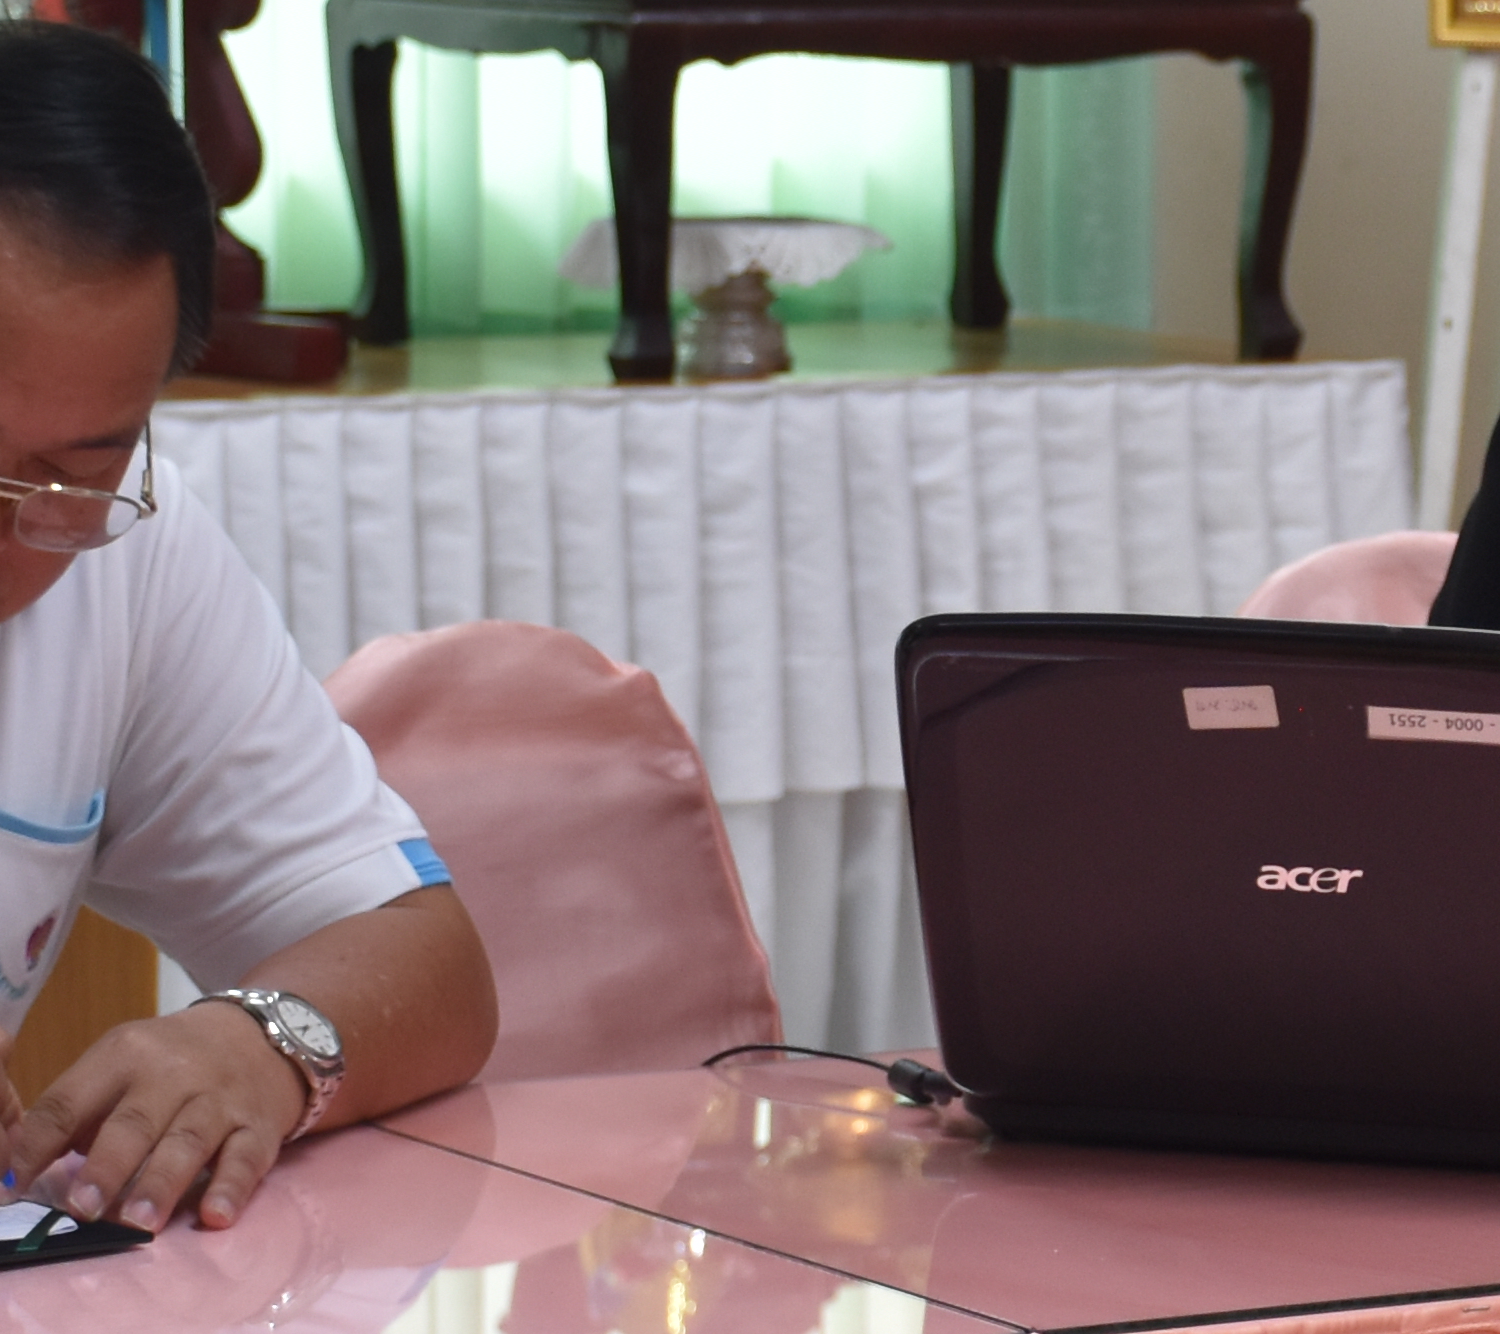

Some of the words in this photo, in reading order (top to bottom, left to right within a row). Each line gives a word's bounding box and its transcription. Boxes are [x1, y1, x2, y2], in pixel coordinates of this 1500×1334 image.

[1388, 713, 1427, 728] 2551
[1445, 717, 1484, 732] 0004
[1256, 865, 1363, 894] acer
